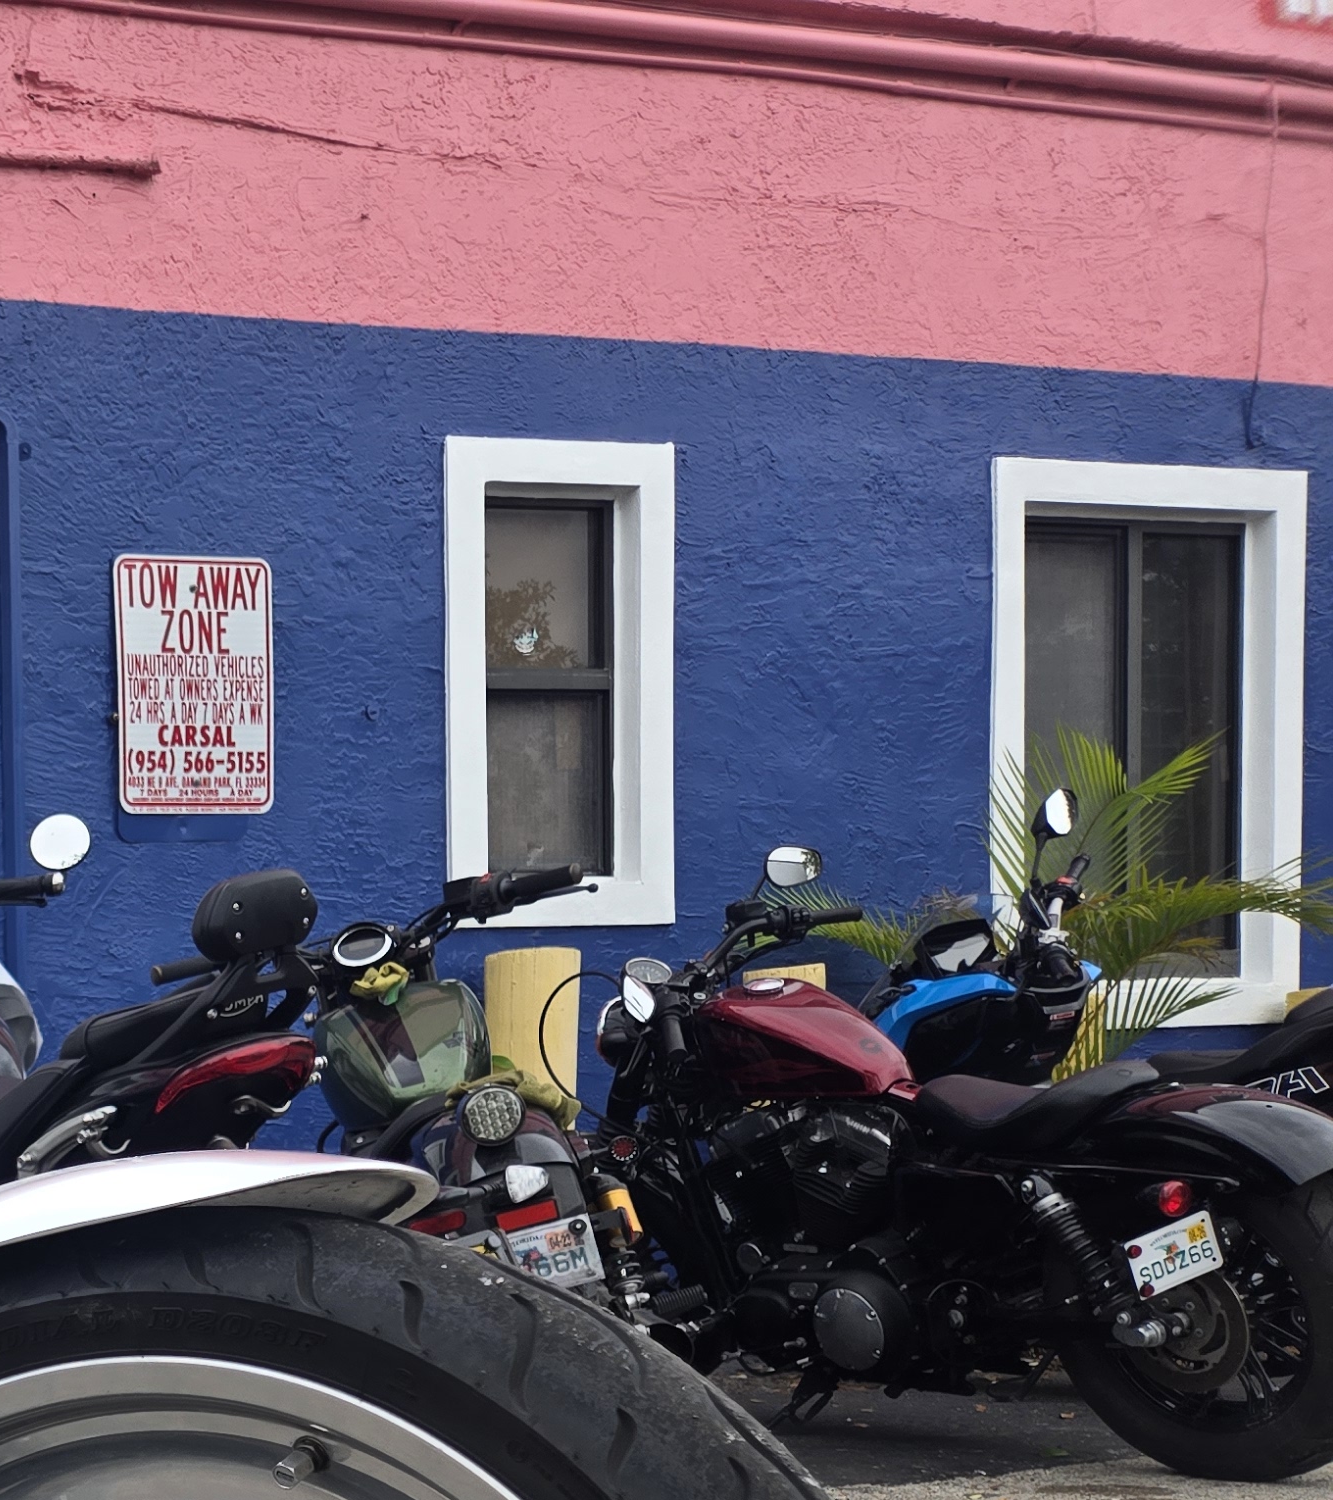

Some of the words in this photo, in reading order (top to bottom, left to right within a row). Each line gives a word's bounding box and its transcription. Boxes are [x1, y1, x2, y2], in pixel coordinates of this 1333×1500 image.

[124, 562, 178, 609] TOW
[194, 566, 261, 610] AWAY
[161, 609, 230, 655] ZONE
[127, 653, 209, 677] UNAUTHORIZED
[214, 656, 264, 679] VEHICLES
[128, 677, 160, 700] TOWED
[165, 678, 175, 700] AT
[180, 678, 219, 701] OWNERS
[223, 679, 265, 702] EXPENSE
[130, 701, 142, 724] 24
[146, 701, 165, 724] HRS
[171, 702, 177, 724] A
[181, 702, 198, 724] DAY
[202, 702, 208, 724] 7
[212, 702, 235, 725] DAYS
[239, 703, 245, 725] A
[250, 703, 263, 725] WK
[158, 724, 236, 747] CARSAL
[128, 748, 175, 775] (954)
[183, 751, 266, 774] 566-5155
[182, 776, 211, 788] OAKAND
[191, 789, 219, 797] HOURS
[238, 789, 253, 797] DAY
